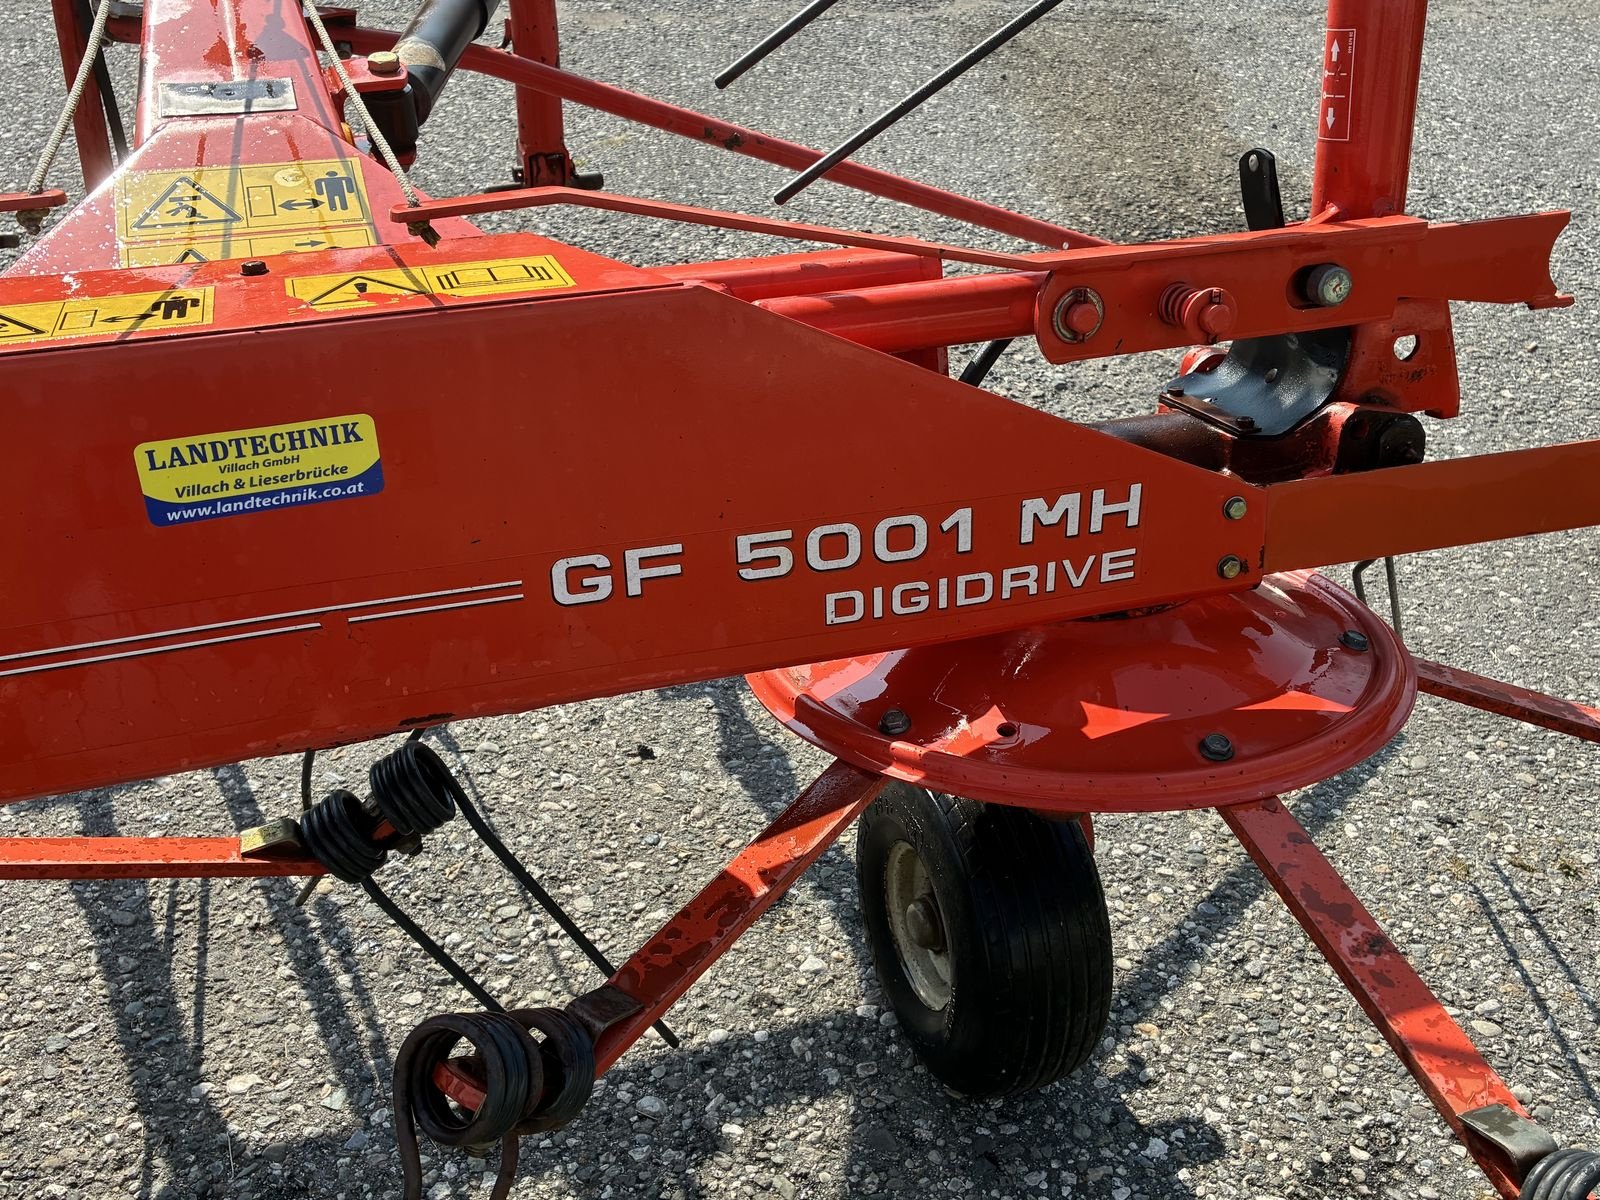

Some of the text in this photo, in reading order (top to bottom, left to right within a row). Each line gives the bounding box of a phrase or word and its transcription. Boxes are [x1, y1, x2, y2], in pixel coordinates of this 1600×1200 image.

[145, 421, 363, 471] LANDTECHNIK
[219, 454, 300, 474] Villach GmbH
[166, 481, 364, 521] www.landtechnik.co.at
[174, 463, 349, 498] Villach & Lieserbrücke
[550, 482, 1143, 607] GF 5001 MH
[825, 547, 1136, 626] DIGIDRIVE
